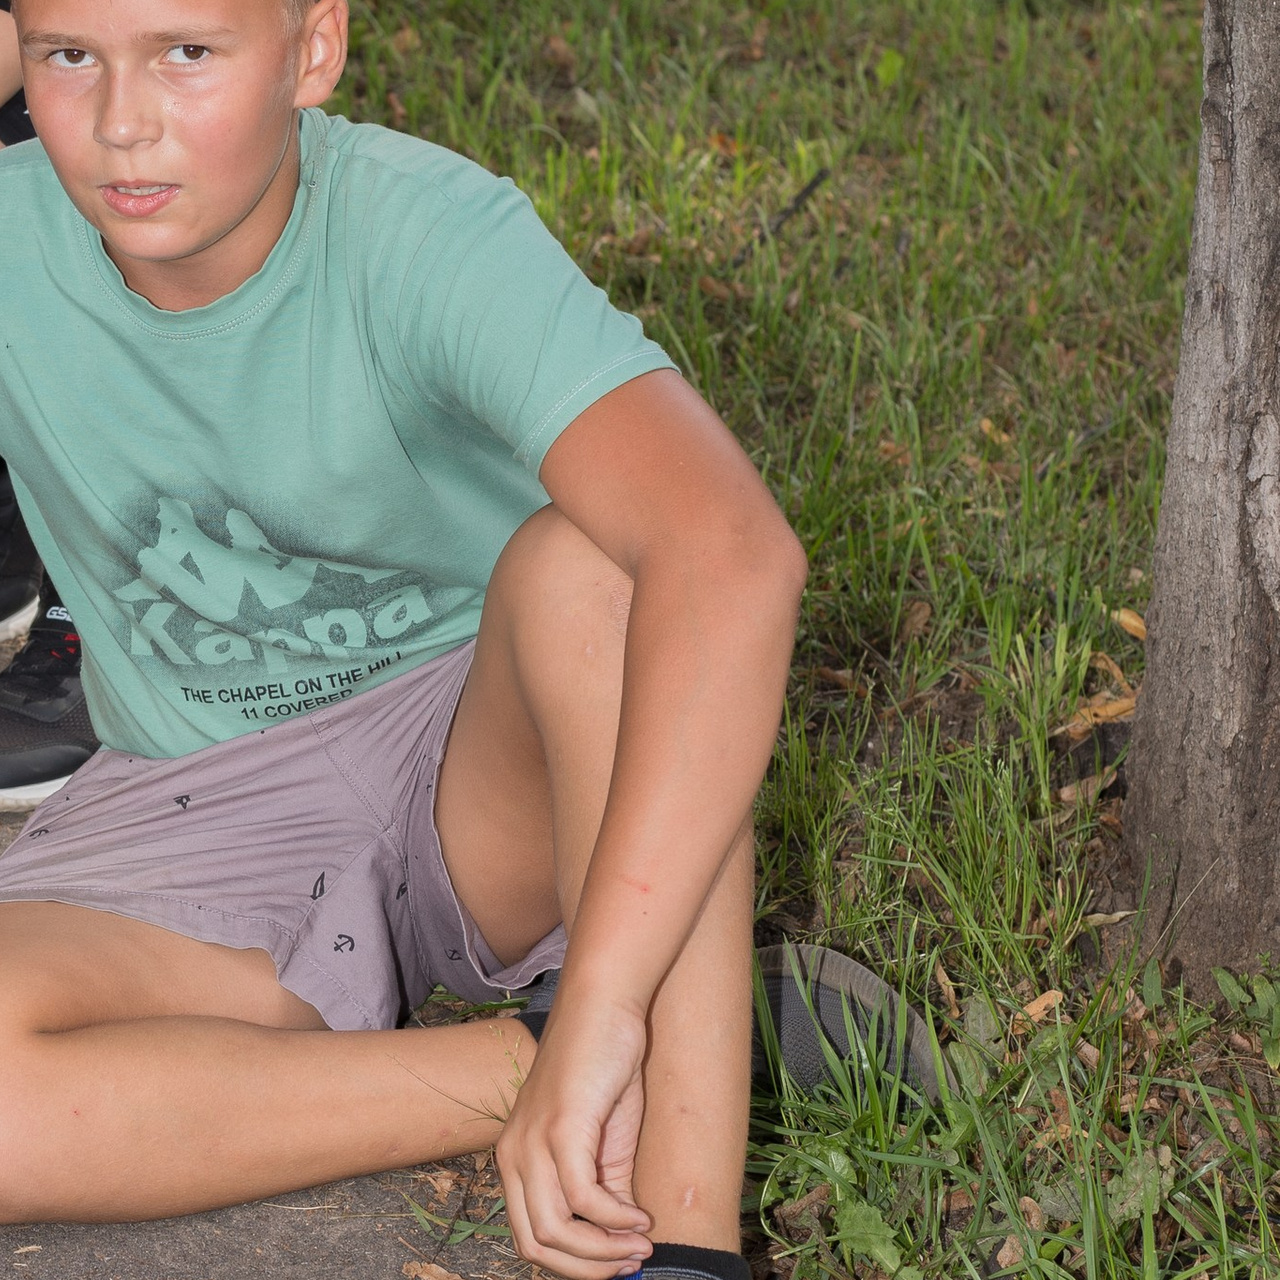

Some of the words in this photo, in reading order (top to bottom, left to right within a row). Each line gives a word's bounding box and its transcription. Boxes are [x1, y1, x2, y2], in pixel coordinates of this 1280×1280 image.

[119, 584, 433, 674] Kappa
[181, 687, 214, 704] THE
[218, 683, 292, 704] CHAPEL
[294, 676, 323, 696] ON
[326, 668, 365, 689] THE
[241, 707, 260, 720] 11
[264, 688, 353, 718] COVERED
